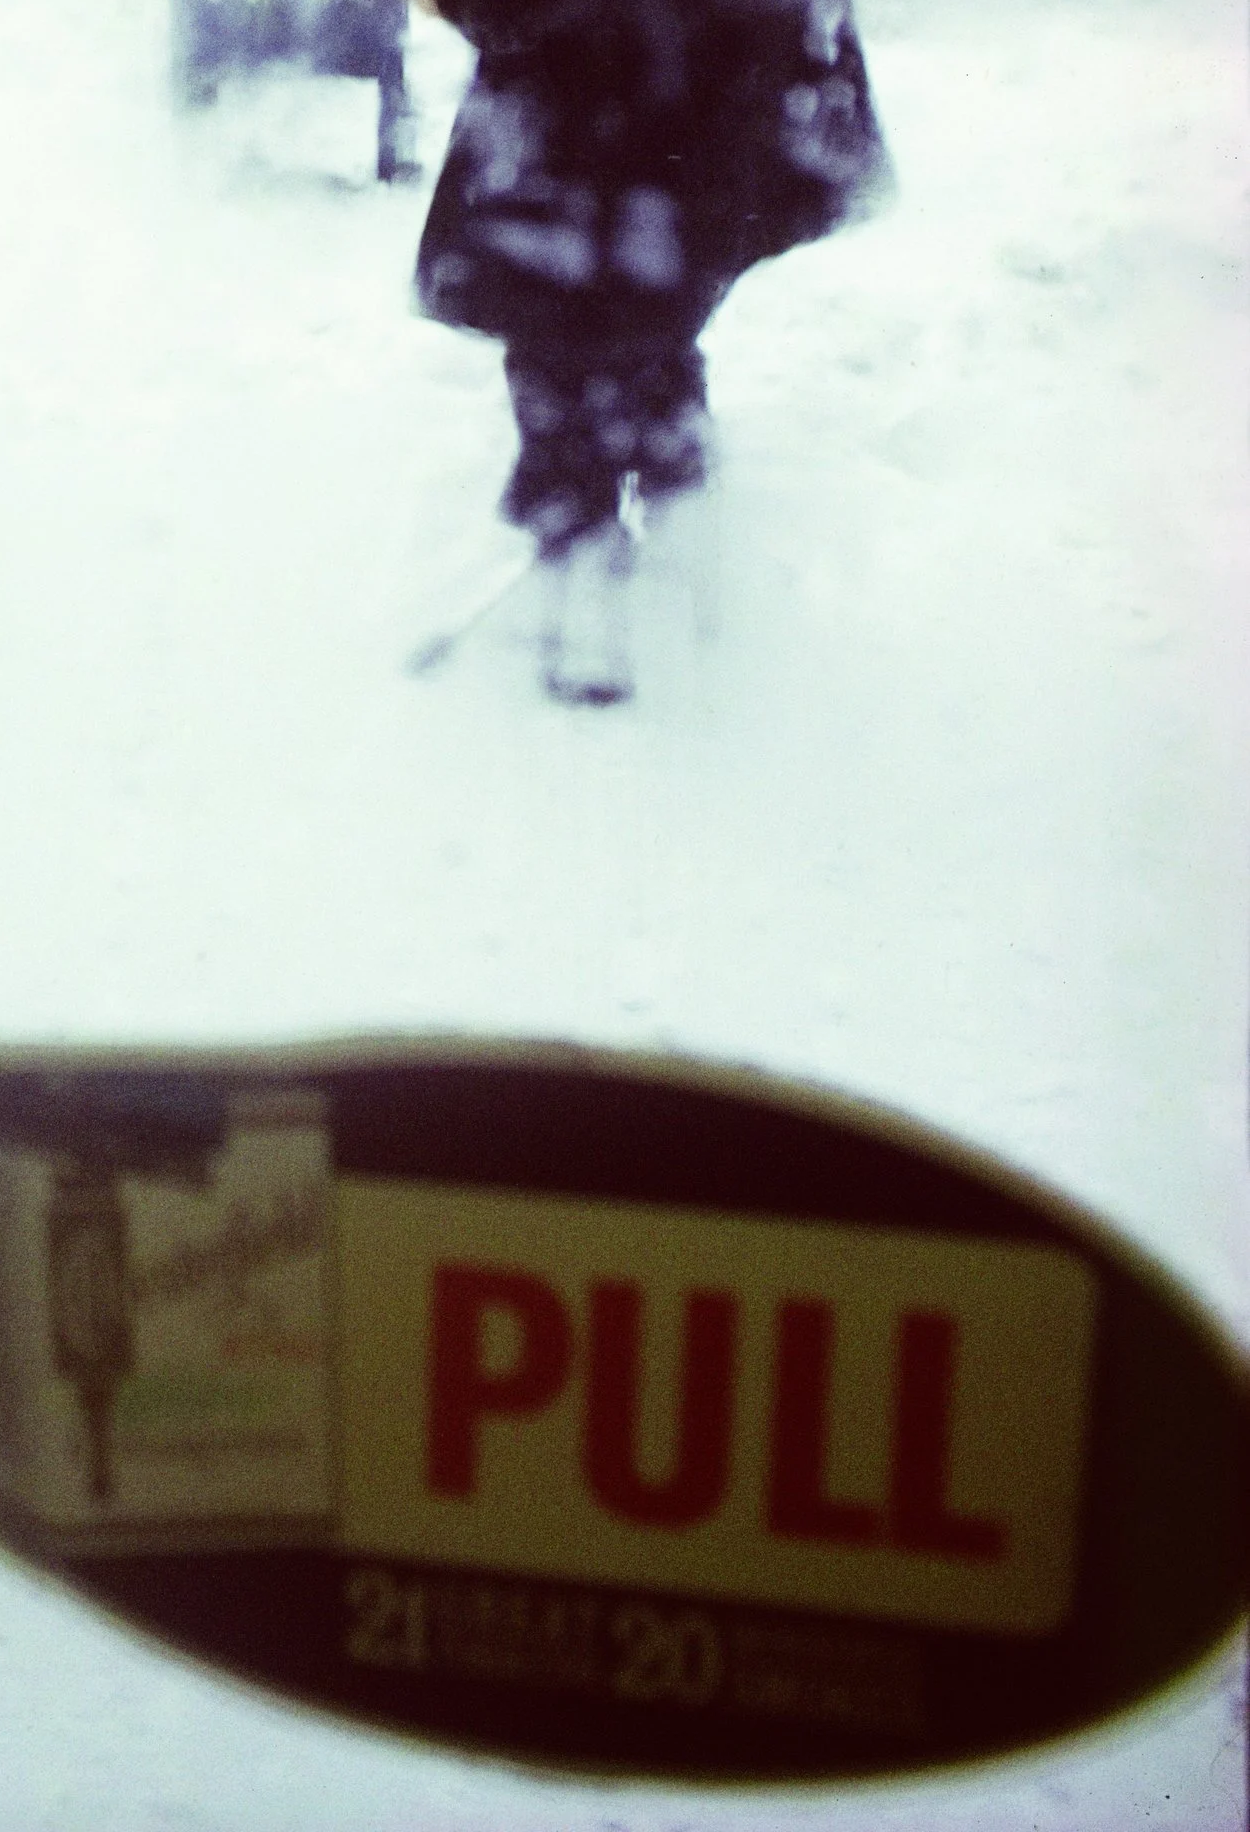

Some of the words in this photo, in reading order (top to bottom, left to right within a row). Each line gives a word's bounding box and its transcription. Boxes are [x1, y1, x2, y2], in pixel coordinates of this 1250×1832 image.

[424, 1261, 1008, 1562] PULL
[345, 1567, 429, 1672] 21
[612, 1604, 724, 1708] 20
